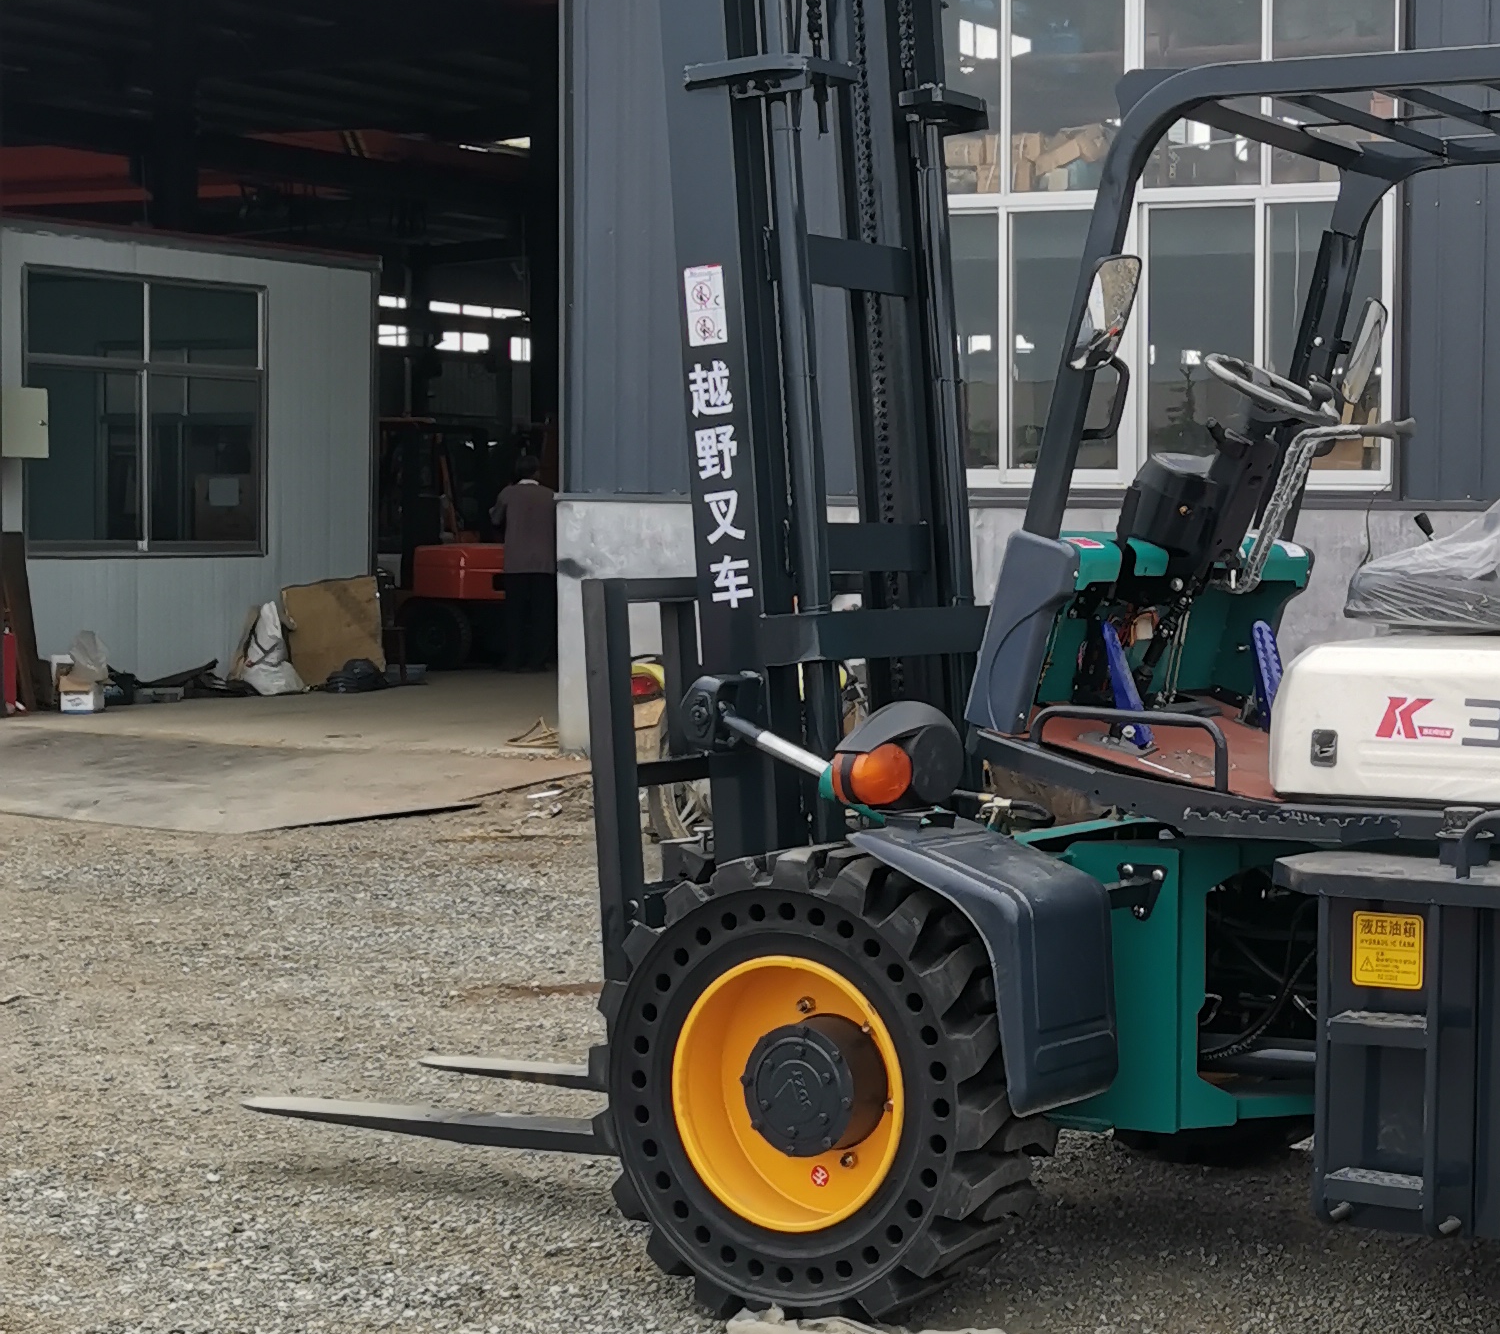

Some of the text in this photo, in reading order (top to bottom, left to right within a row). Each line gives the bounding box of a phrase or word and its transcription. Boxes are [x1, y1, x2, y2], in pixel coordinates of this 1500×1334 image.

[689, 360, 754, 609] 越野叉车
[1375, 695, 1434, 740] K
[1360, 918, 1417, 939] 液压油箱
